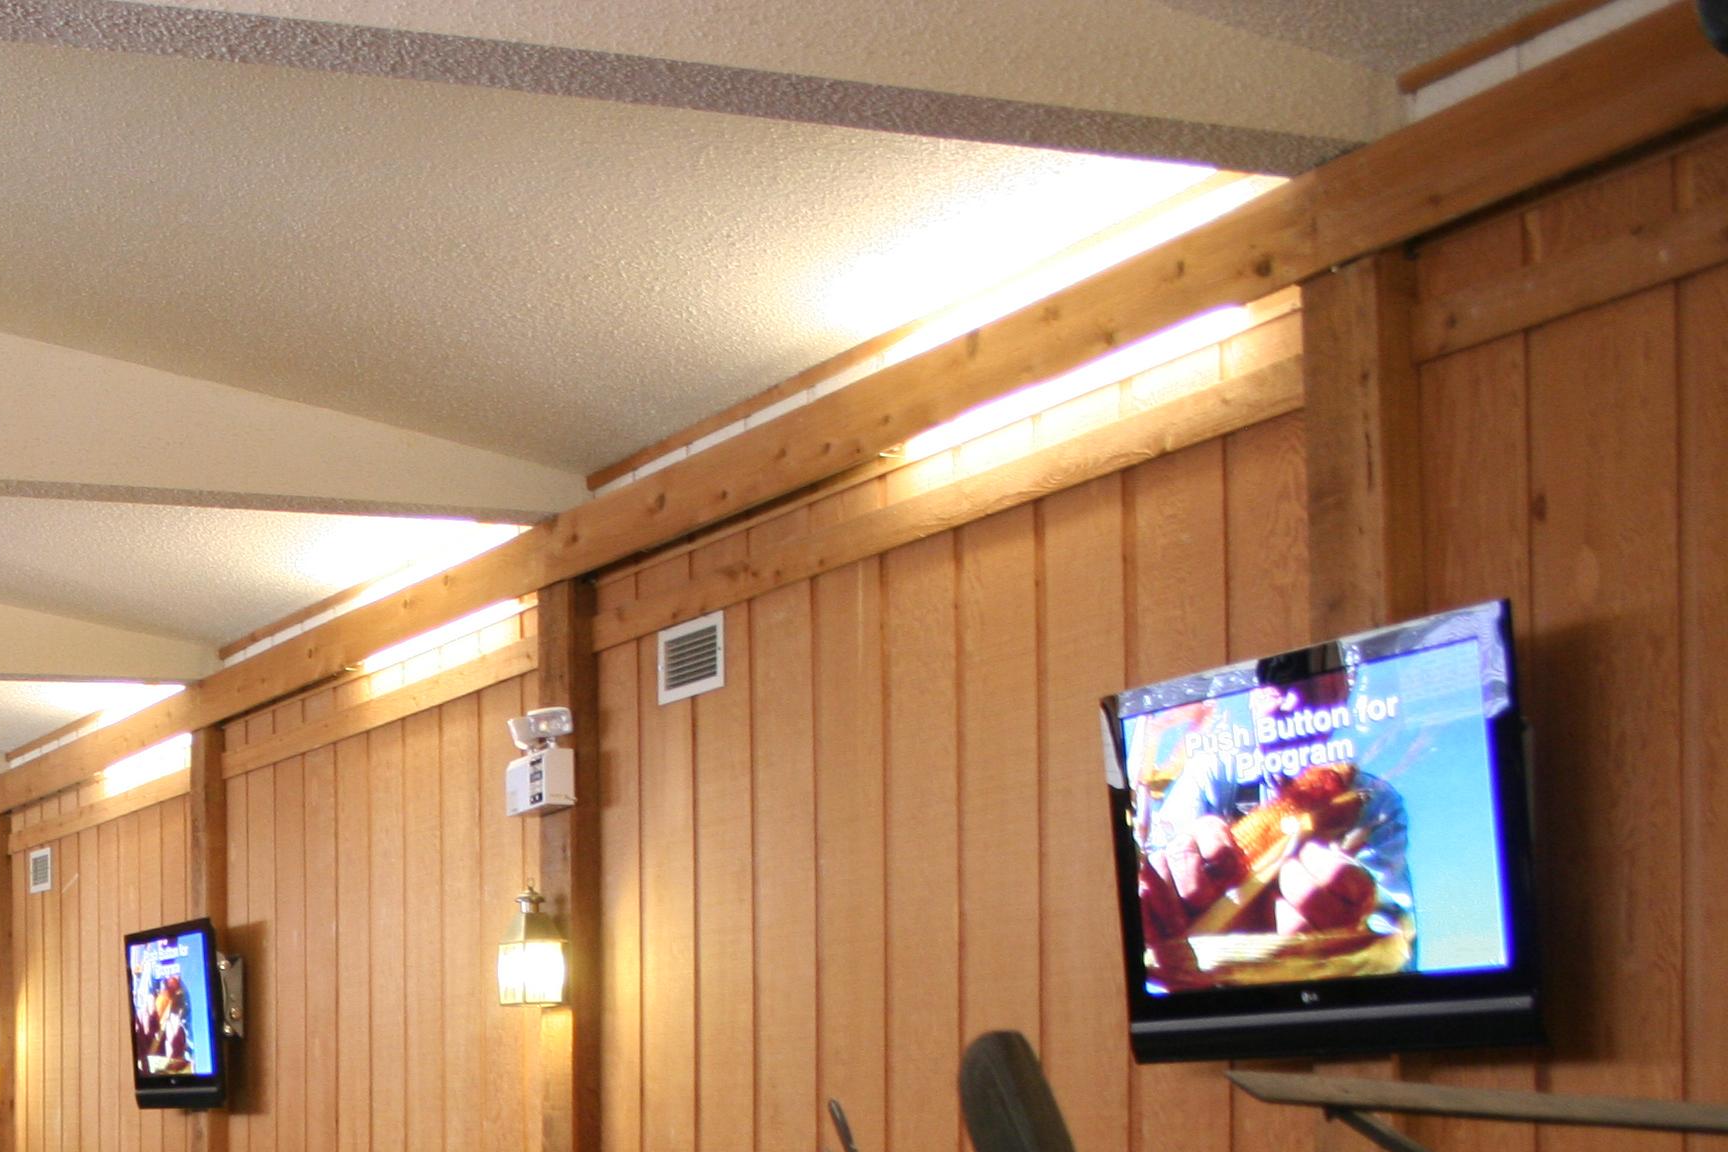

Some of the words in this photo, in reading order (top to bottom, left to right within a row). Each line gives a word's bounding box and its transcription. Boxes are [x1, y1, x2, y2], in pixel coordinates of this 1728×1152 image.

[1184, 723, 1250, 758] Push
[1256, 706, 1350, 743] Button
[1355, 694, 1399, 723] for
[1236, 738, 1354, 778] Program
